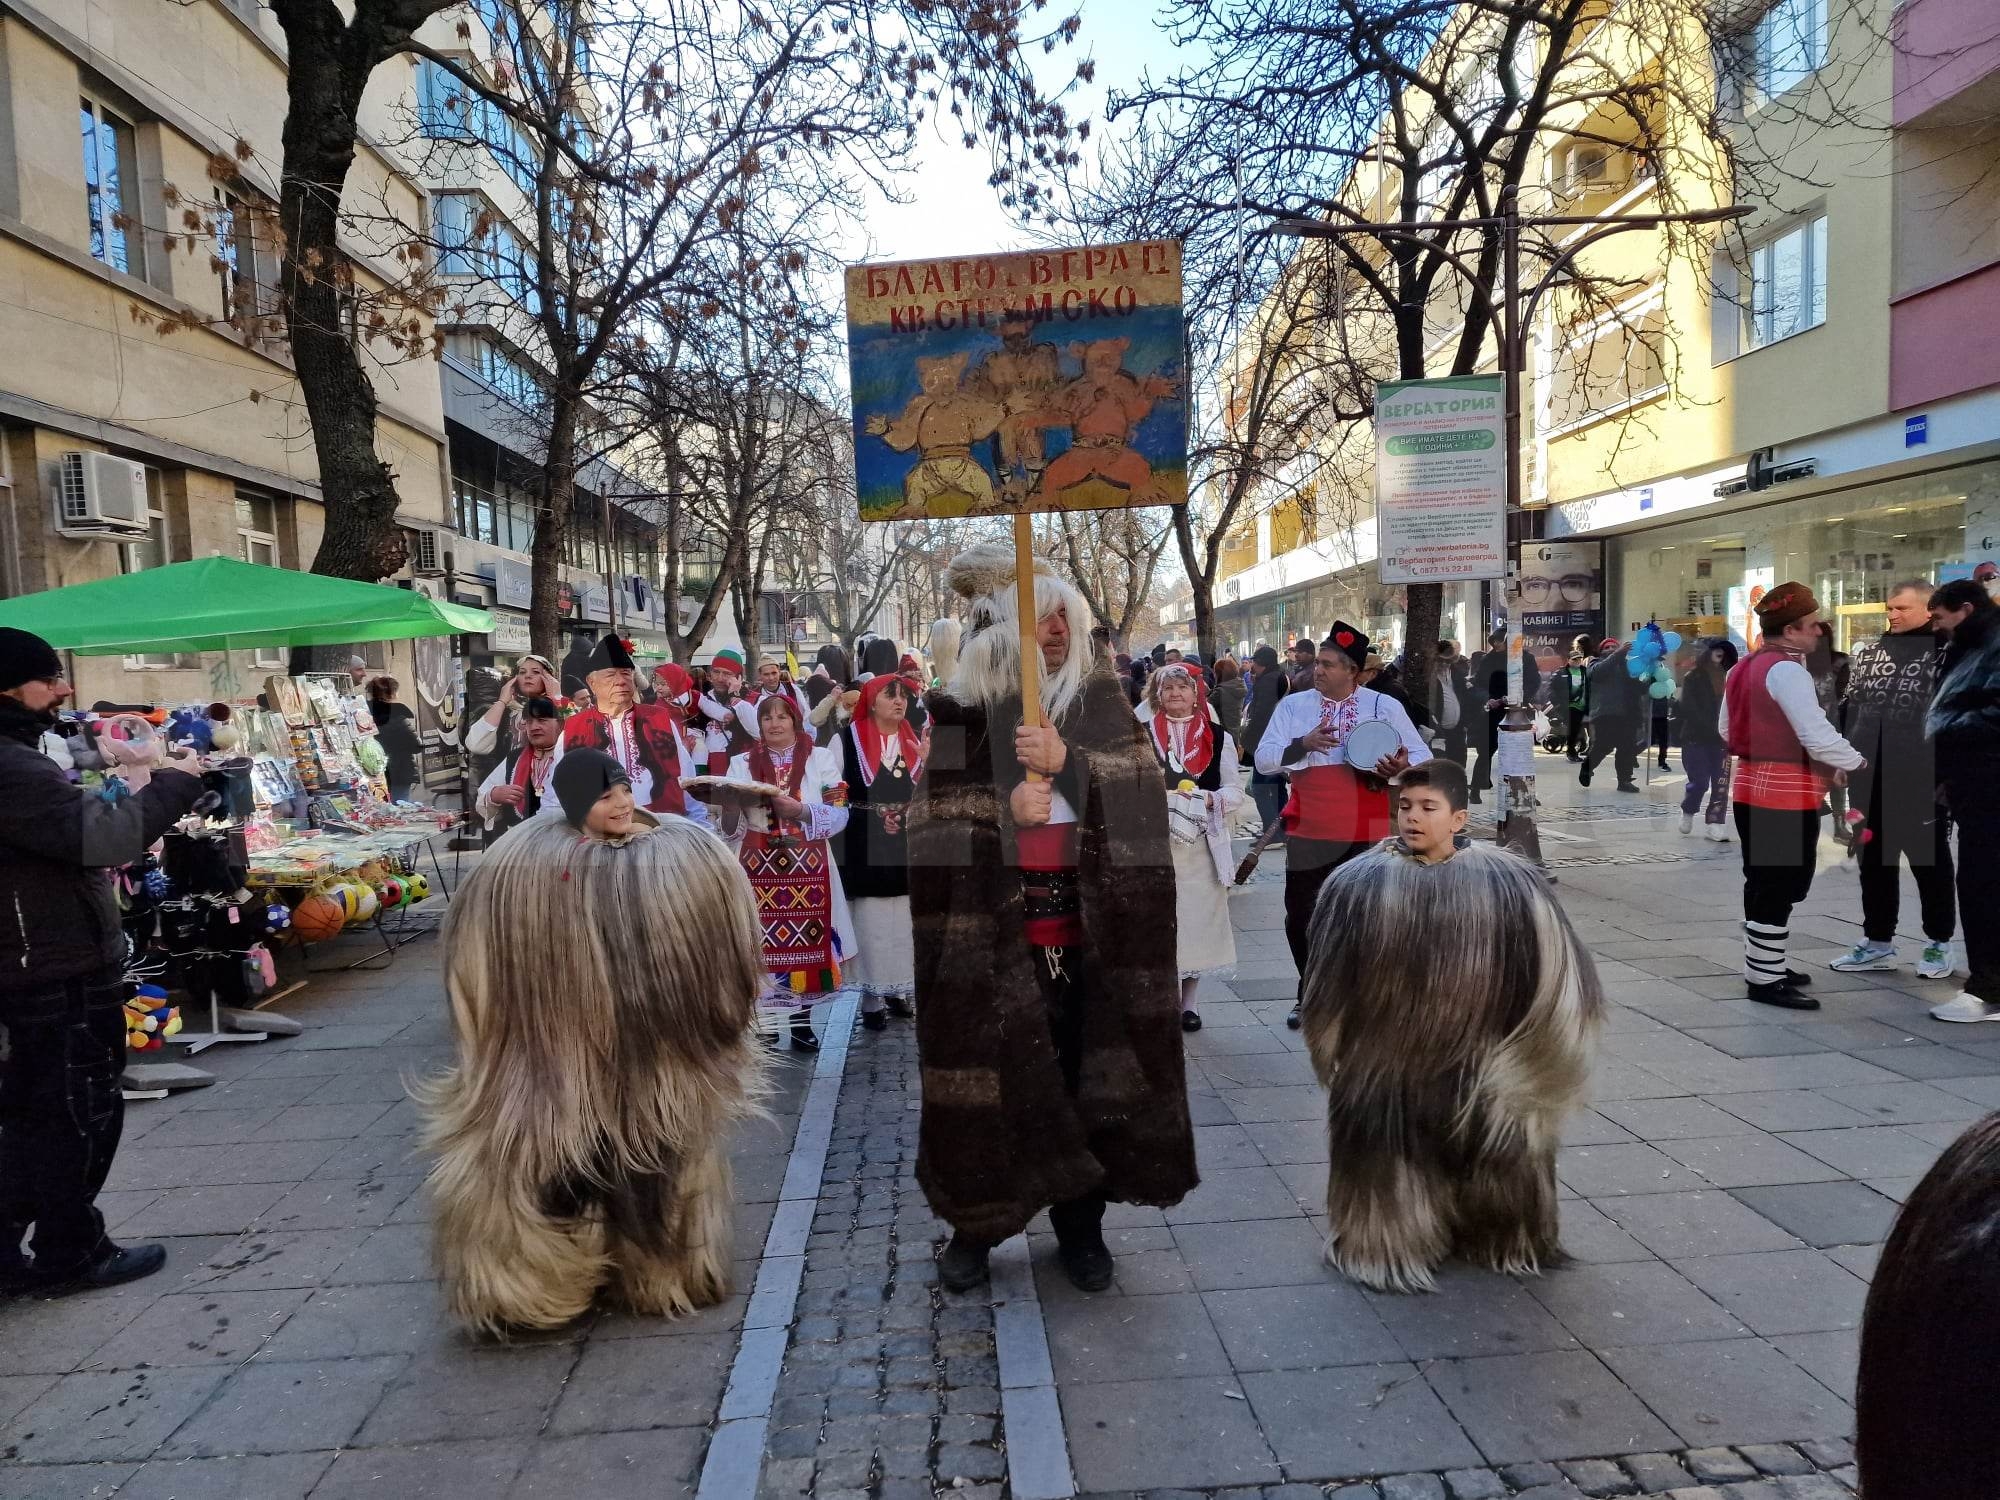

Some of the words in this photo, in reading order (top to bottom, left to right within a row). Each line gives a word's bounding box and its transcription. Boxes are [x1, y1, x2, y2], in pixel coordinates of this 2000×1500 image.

[1384, 397, 1496, 418] ВЕРБАТОРИЯ
[1418, 436, 1445, 444] ИМАТЕ
[1399, 555, 1445, 567] Вербатория
[1523, 615, 1563, 626] КАБИНЕТ
